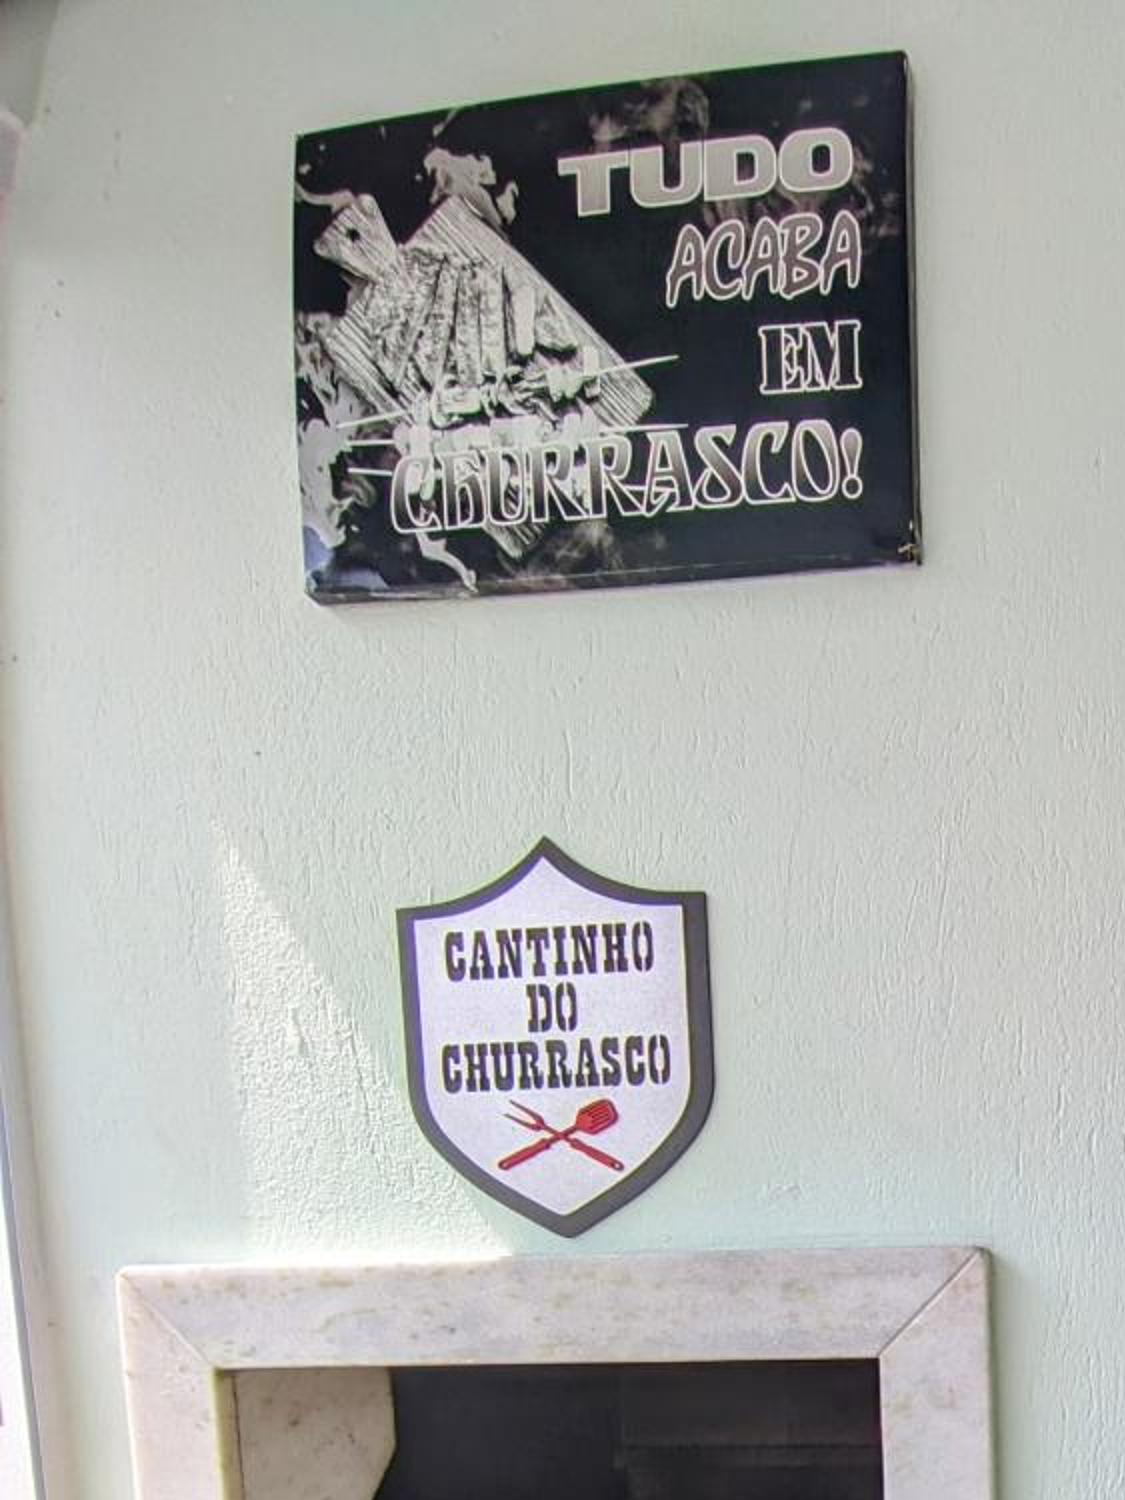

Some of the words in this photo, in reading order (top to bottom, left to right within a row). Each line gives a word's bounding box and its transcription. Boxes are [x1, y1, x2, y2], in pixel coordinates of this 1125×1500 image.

[557, 127, 854, 218] TUDO
[666, 209, 863, 309] ACABA
[759, 319, 863, 395] EM
[444, 920, 655, 982] CANTINHO
[525, 982, 578, 1033] DO
[441, 1034, 672, 1094] CHURRASCO
